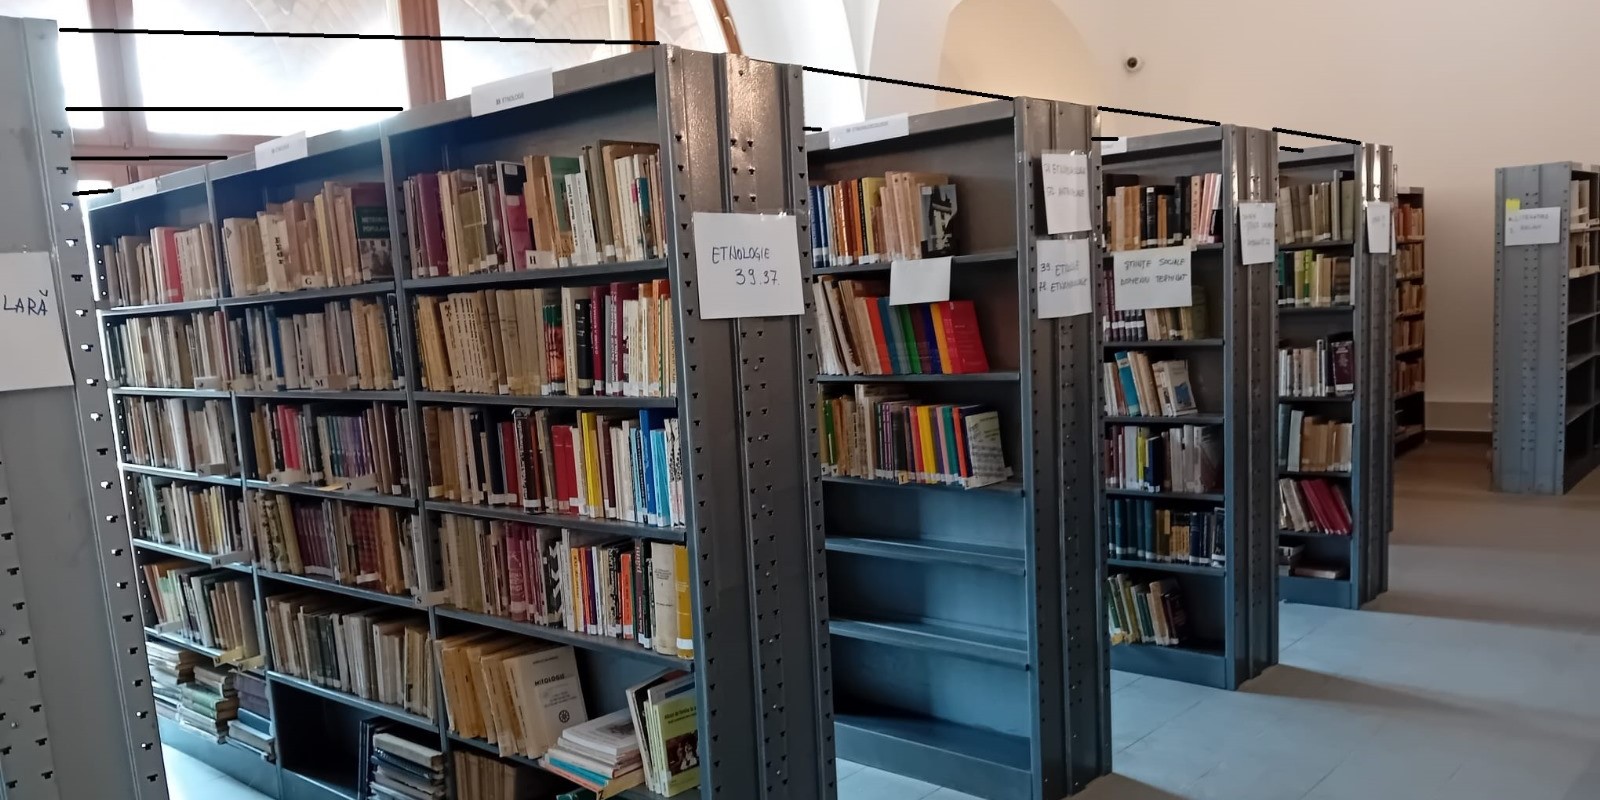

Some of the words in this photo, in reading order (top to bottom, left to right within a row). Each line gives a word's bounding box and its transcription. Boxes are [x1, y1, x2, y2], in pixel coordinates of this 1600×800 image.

[529, 255, 537, 265] H
[711, 245, 770, 264] ETNOLOGIE
[304, 277, 313, 286] G
[3, 289, 48, 316] LARĂ
